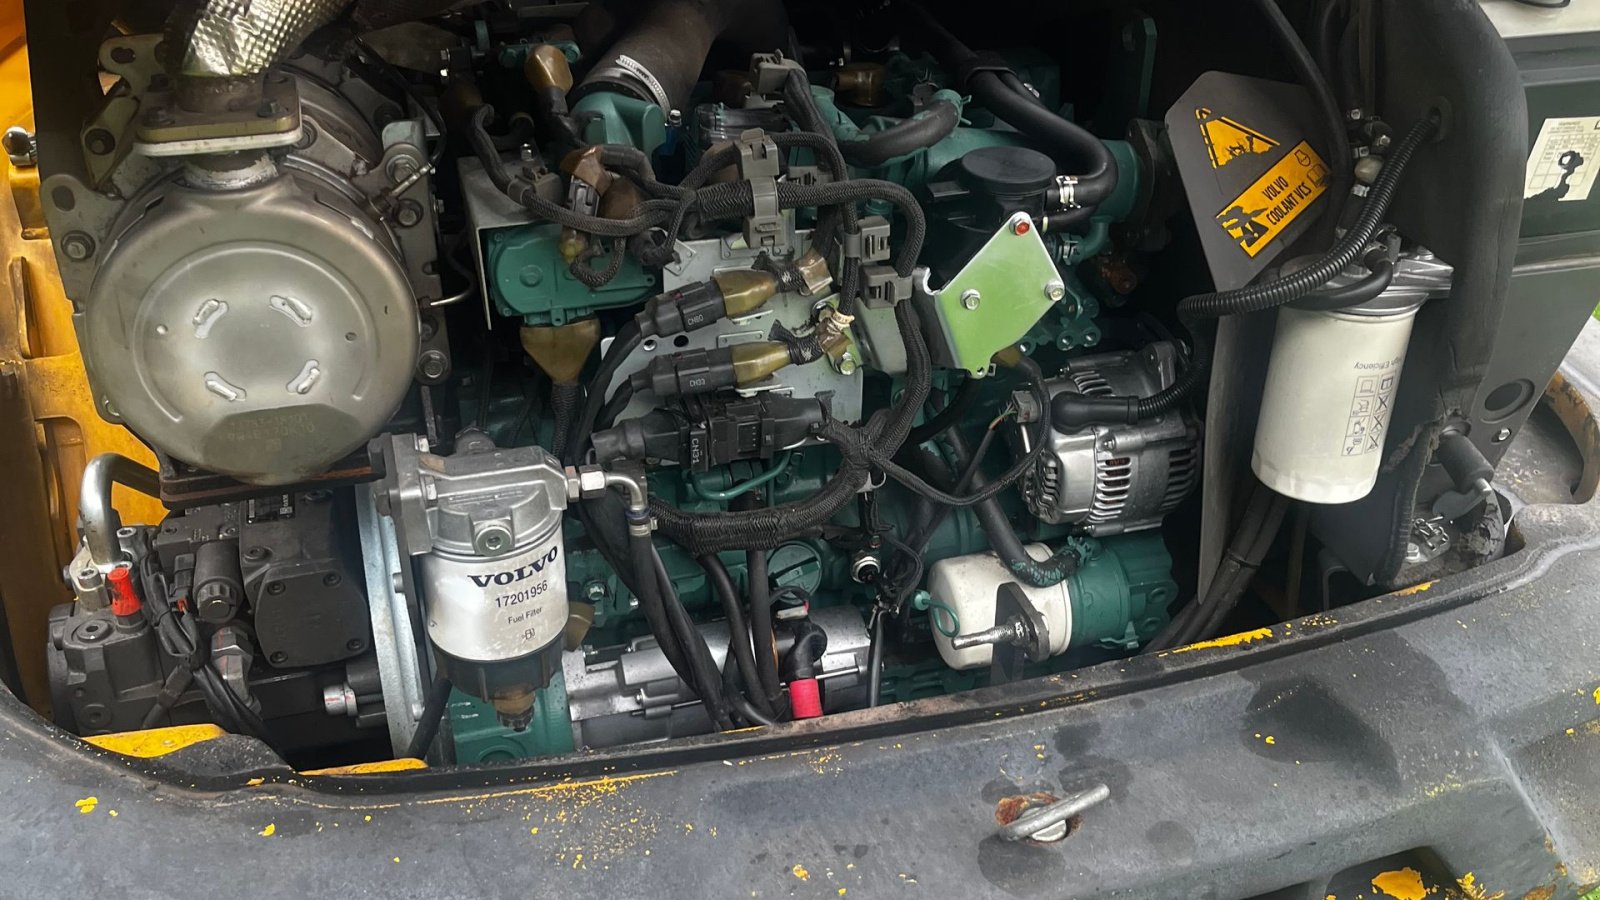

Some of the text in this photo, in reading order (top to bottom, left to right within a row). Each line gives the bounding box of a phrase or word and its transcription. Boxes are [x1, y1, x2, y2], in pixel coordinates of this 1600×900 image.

[1262, 176, 1289, 200] VOLVO
[1266, 182, 1312, 225] COOLANT VCS
[691, 438, 700, 462] CN31
[467, 546, 558, 588] VOLVO
[495, 580, 547, 608] 17201956
[508, 606, 543, 625] Fuel Filter
